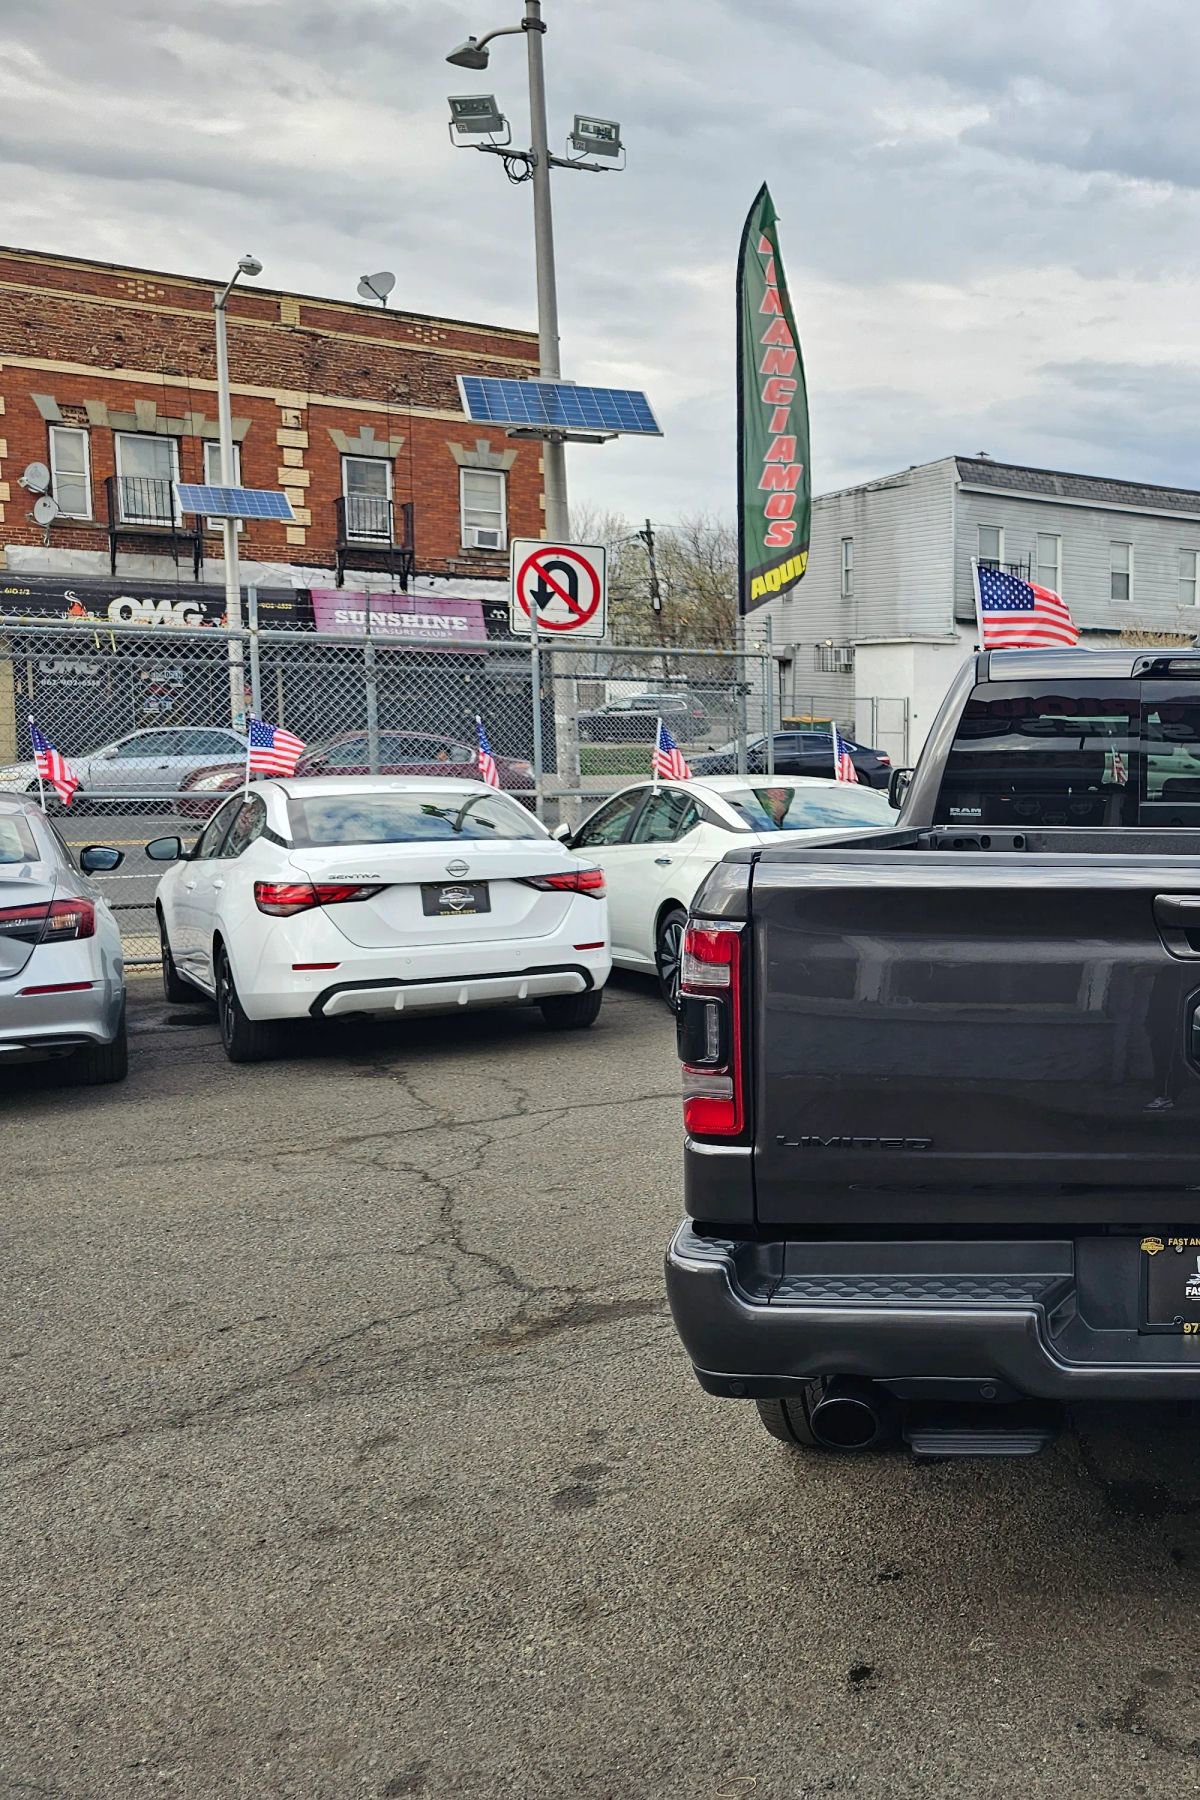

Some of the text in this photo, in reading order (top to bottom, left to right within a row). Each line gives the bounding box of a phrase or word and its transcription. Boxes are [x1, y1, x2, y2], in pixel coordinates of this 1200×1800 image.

[751, 550, 809, 601] AQUI!
[333, 609, 468, 632] SUNSHINE
[1168, 1238, 1189, 1246] FAST
